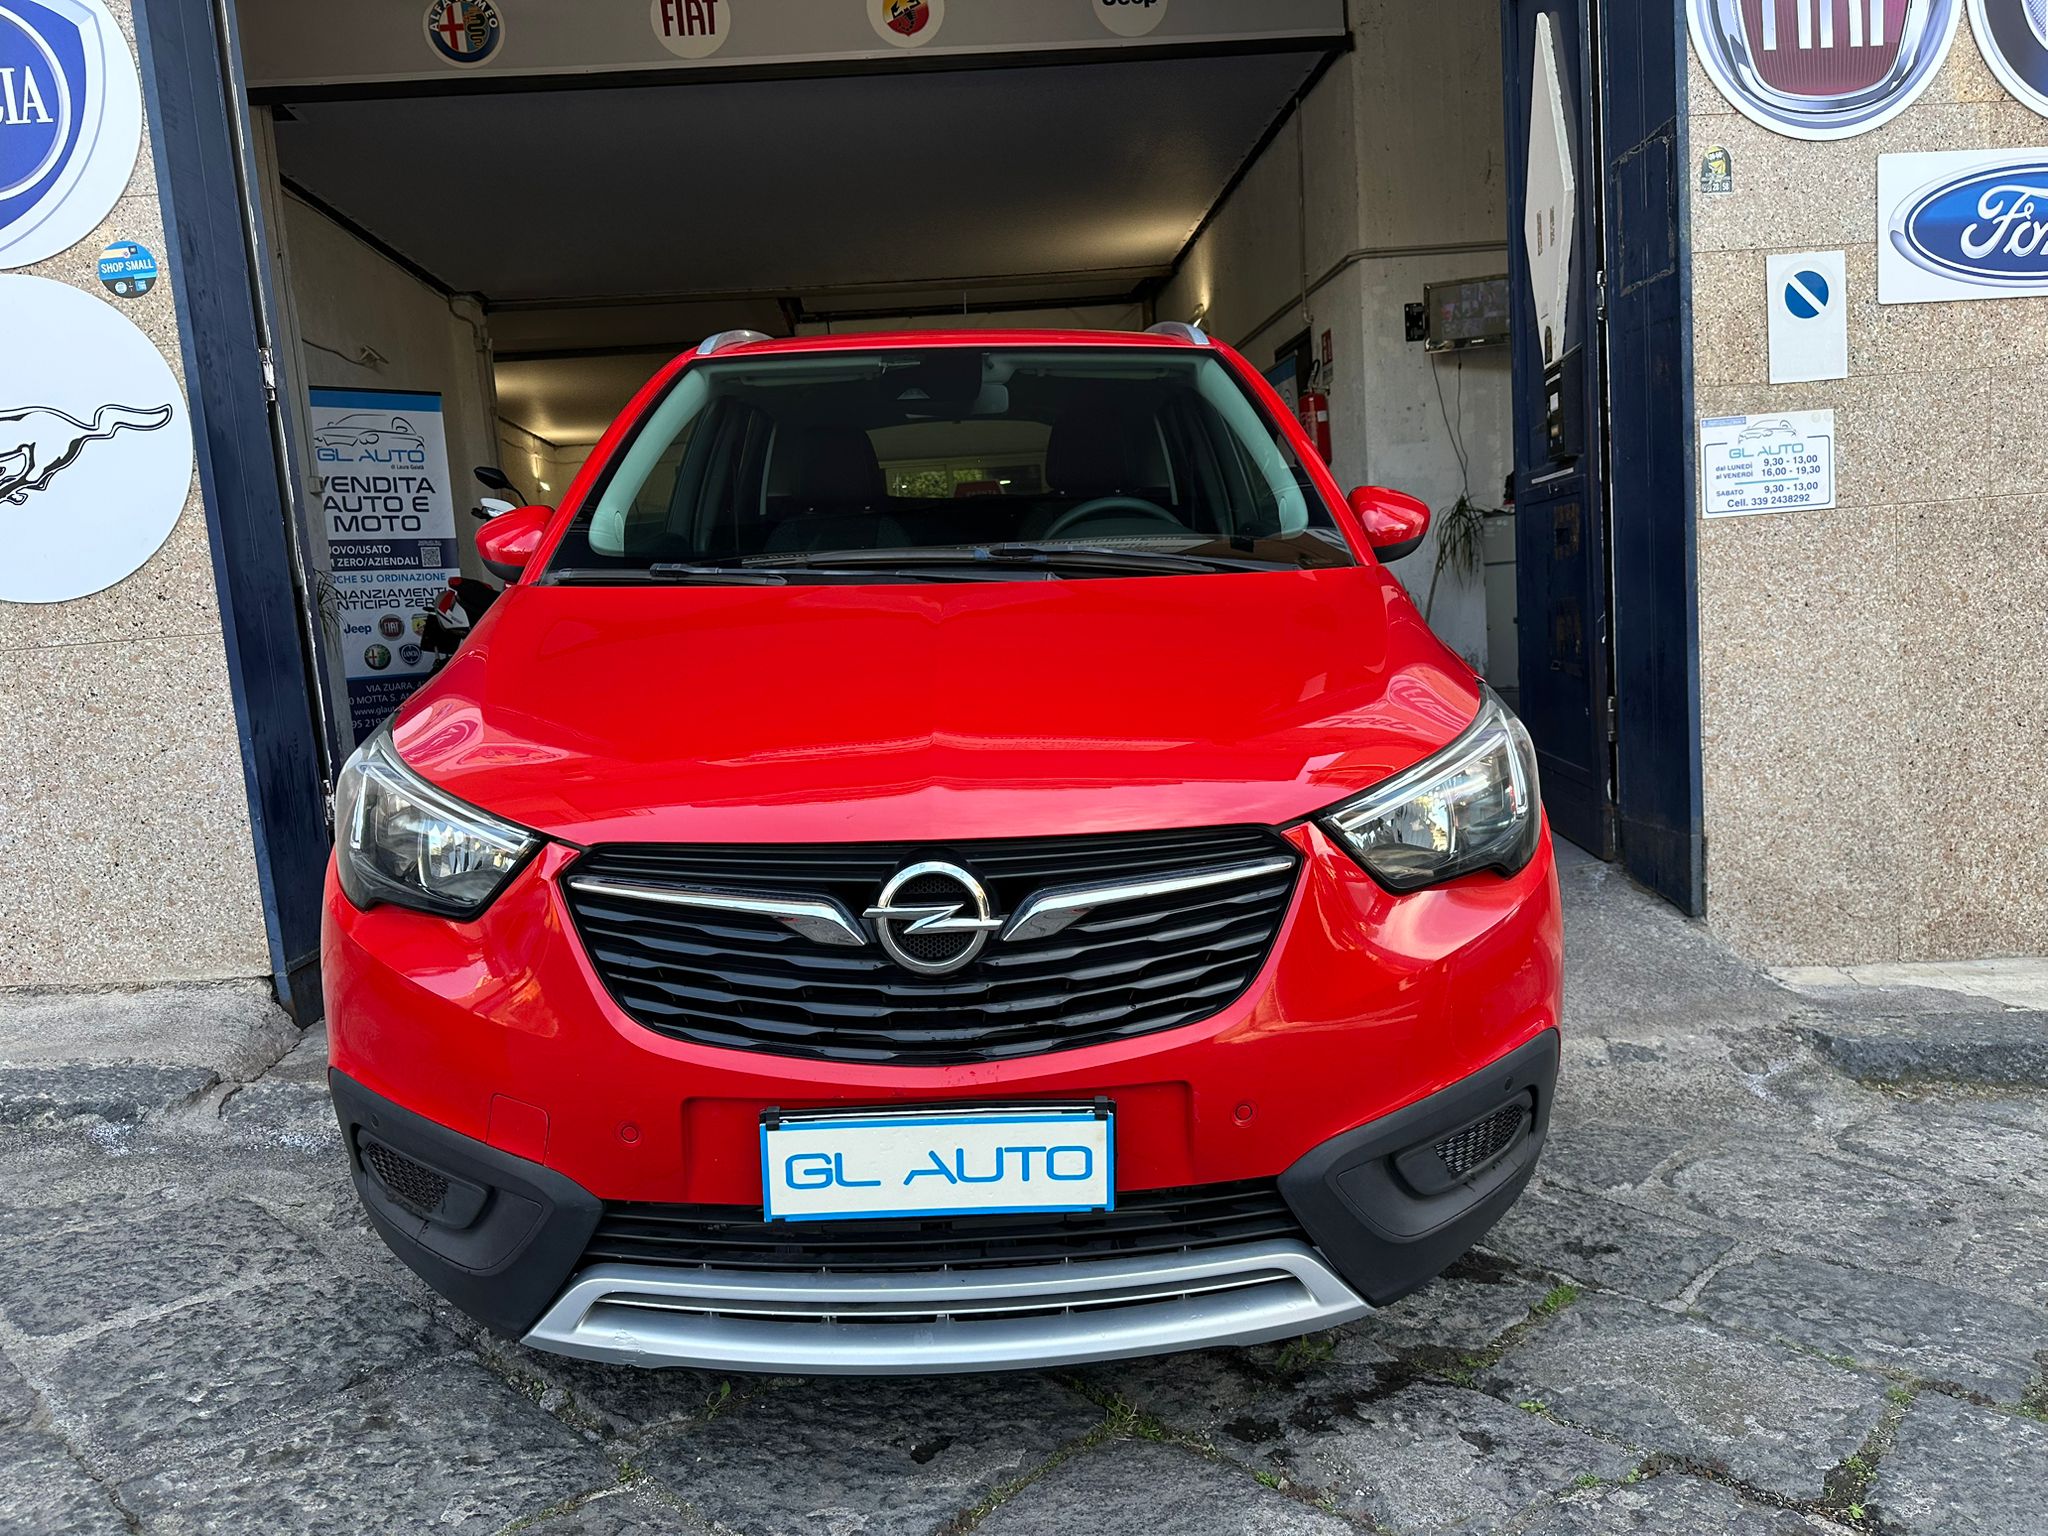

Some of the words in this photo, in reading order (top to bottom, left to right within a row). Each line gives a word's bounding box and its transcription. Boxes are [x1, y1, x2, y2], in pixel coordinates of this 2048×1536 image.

[660, 0, 718, 36] FIAT
[100, 261, 124, 274] SHOP
[125, 258, 154, 271] SMALL
[317, 448, 353, 462] GL
[359, 449, 425, 463] AUTO
[1729, 448, 1754, 459] GL
[1757, 443, 1804, 457] AUTO
[1763, 457, 1784, 467] 9,30
[1793, 454, 1818, 466] 13,00
[1762, 467, 1787, 478] 16,00
[1796, 465, 1821, 476] 19,30
[1716, 489, 1744, 497] SABATO
[1764, 484, 1784, 495] 9,30
[1793, 481, 1818, 493] 13,00
[324, 495, 404, 512] AUTO
[412, 496, 430, 512] E
[1727, 499, 1749, 508] Cell.
[1751, 496, 1768, 506] 339
[1771, 493, 1810, 505] 2438292
[333, 515, 422, 532] MOTO
[337, 556, 419, 567] ZERO/AZIENDALI
[360, 574, 373, 583] SU
[376, 572, 446, 583] ORDINAZIONE
[344, 623, 372, 635] Jeep
[383, 621, 399, 634] FIAT
[366, 684, 382, 693] VIA
[357, 694, 389, 705] MOTTA
[784, 1152, 881, 1190] GL
[902, 1145, 1094, 1186] AUTO
